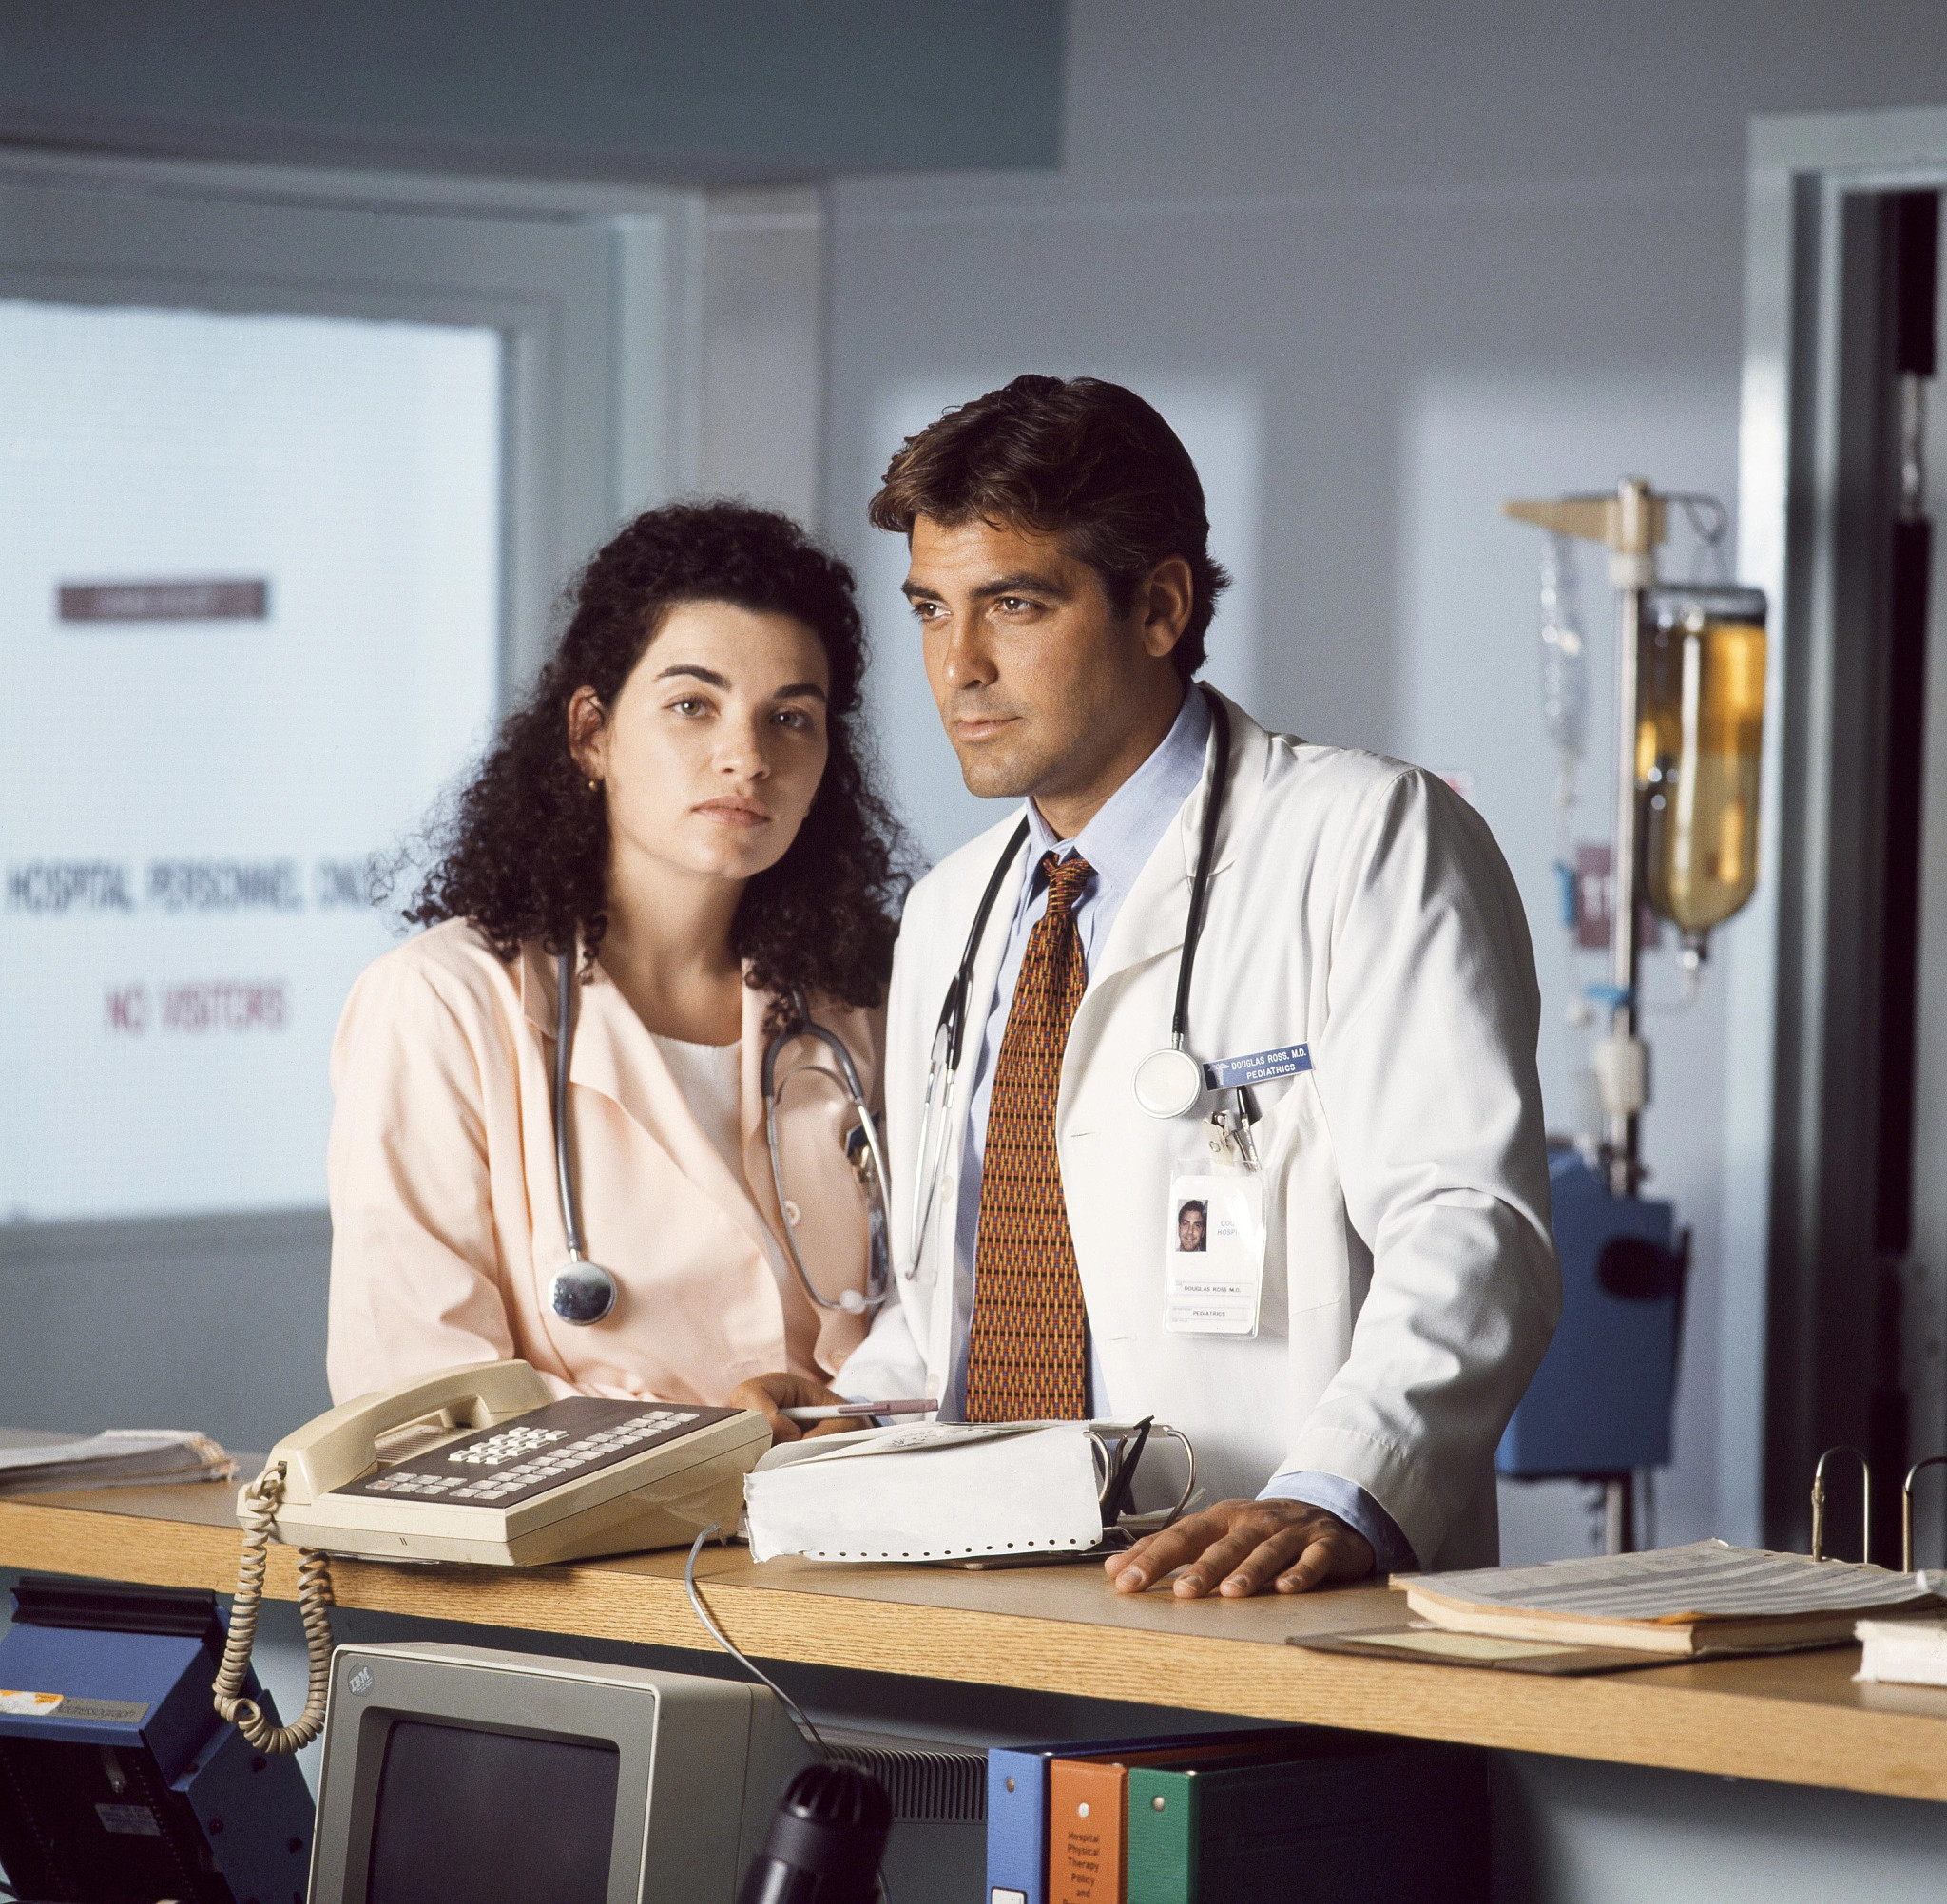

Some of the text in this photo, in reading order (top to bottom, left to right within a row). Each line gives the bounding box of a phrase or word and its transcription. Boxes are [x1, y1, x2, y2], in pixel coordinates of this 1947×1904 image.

[9, 856, 134, 913] HOSPITAL
[146, 855, 301, 913] PERSONNEL
[106, 979, 286, 1033] NO VISITORS
[1231, 1056, 1265, 1070] DOUGLAS
[1291, 1048, 1307, 1059] M.D.
[1246, 1063, 1296, 1080] PEDIATRICS
[1068, 1832, 1099, 1842] Hospital
[1068, 1843, 1099, 1856] Physical
[1068, 1856, 1099, 1873] Therapy
[1071, 1873, 1095, 1887] Policy
[1076, 1889, 1090, 1897] and
